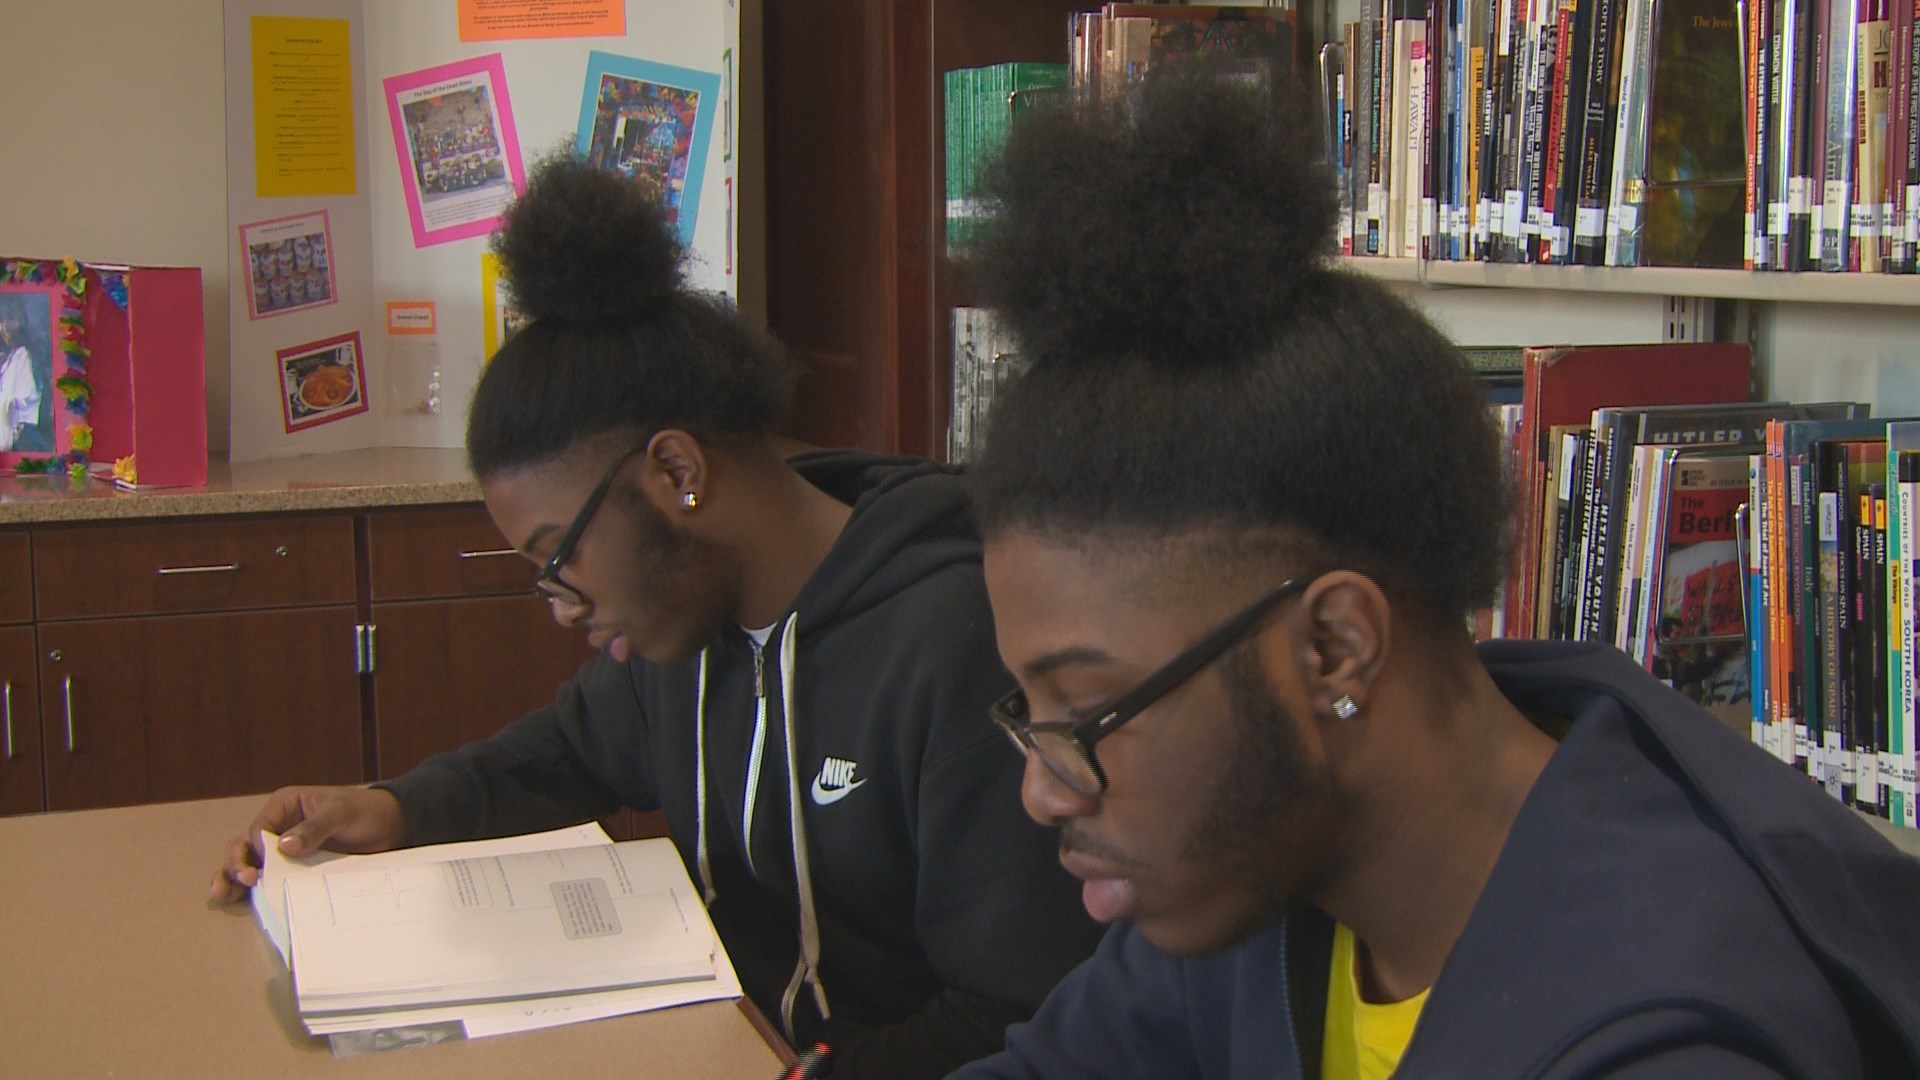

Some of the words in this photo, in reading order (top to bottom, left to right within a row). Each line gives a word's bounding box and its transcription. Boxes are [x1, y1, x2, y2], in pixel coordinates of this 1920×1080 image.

[1600, 0, 1609, 43] EOPLE'S
[1692, 15, 1711, 28] The
[1711, 17, 1733, 29] Jews
[1595, 46, 1605, 84] STORY
[1773, 34, 1781, 74] COMMON
[1912, 37, 1920, 65] STORY
[1537, 65, 1546, 103] HOLOCAUST
[1621, 75, 1629, 101] World
[1771, 75, 1779, 105] VIRTUE
[1758, 96, 1764, 108] ON
[1371, 104, 1380, 154] Landmarks
[1475, 87, 1483, 147] MONUMENTS
[1527, 105, 1536, 132] World
[1827, 140, 1842, 180] Airm
[1908, 144, 1916, 169] BOMB
[1587, 428, 1596, 451] THE
[1653, 429, 1742, 444] HITLER
[1604, 427, 1614, 480] BARTOLETTI
[1584, 456, 1595, 498] THIRD
[1681, 496, 1705, 509] The
[1581, 499, 1592, 538] REICH
[1590, 515, 1599, 550] Holocaust,
[1680, 507, 1734, 534] Berl
[1597, 504, 1609, 567] HITLER
[1761, 543, 1768, 553] of
[1876, 532, 1884, 565] SPAIN
[1587, 552, 1595, 579] Hitler,
[1625, 543, 1634, 571] Kampf
[1763, 578, 1769, 589] of
[1803, 566, 1813, 593] Italy
[1840, 580, 1845, 594] ON
[1591, 574, 1603, 633] YOUTH
[1827, 593, 1834, 602] A
[1827, 606, 1835, 658] HISTORY
[1828, 662, 1835, 679] OF
[820, 757, 857, 788] NIKE
